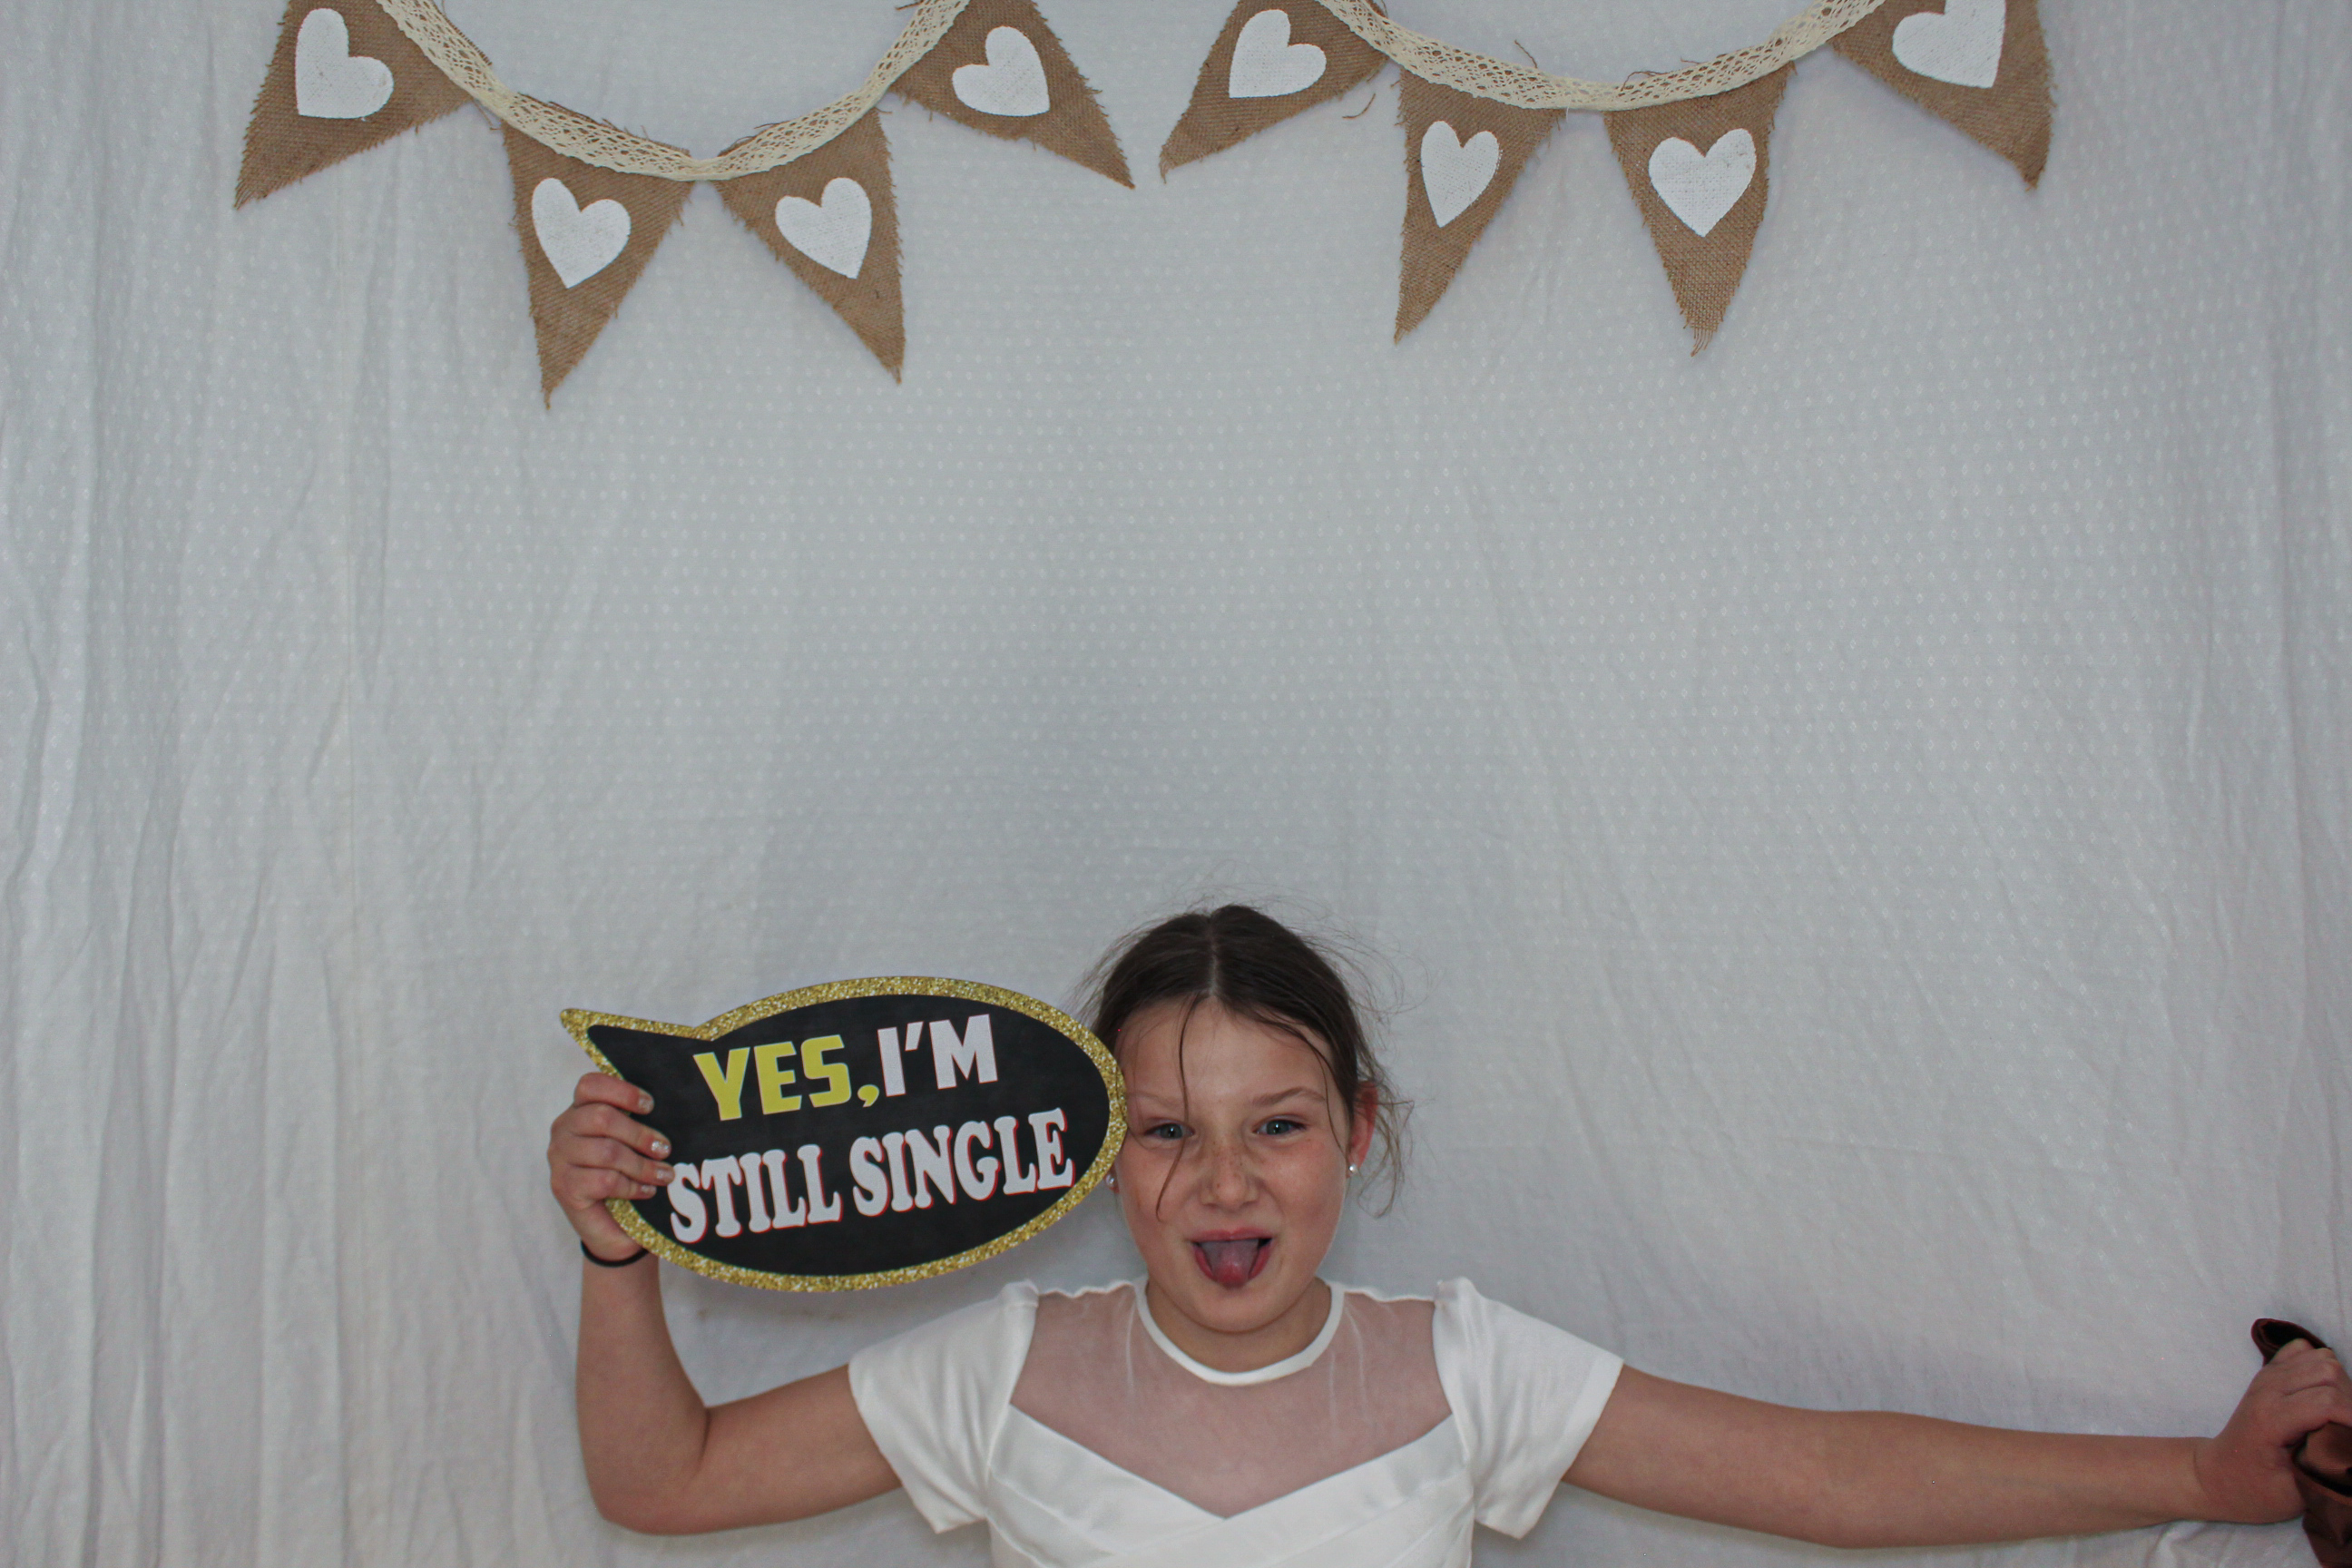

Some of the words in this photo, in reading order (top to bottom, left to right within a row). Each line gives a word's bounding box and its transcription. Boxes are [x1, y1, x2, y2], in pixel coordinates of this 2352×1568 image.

[692, 1034, 880, 1122] YES,
[877, 1014, 999, 1097] I'M
[667, 1144, 842, 1244] STILL
[849, 1107, 1074, 1217] SINGLE
